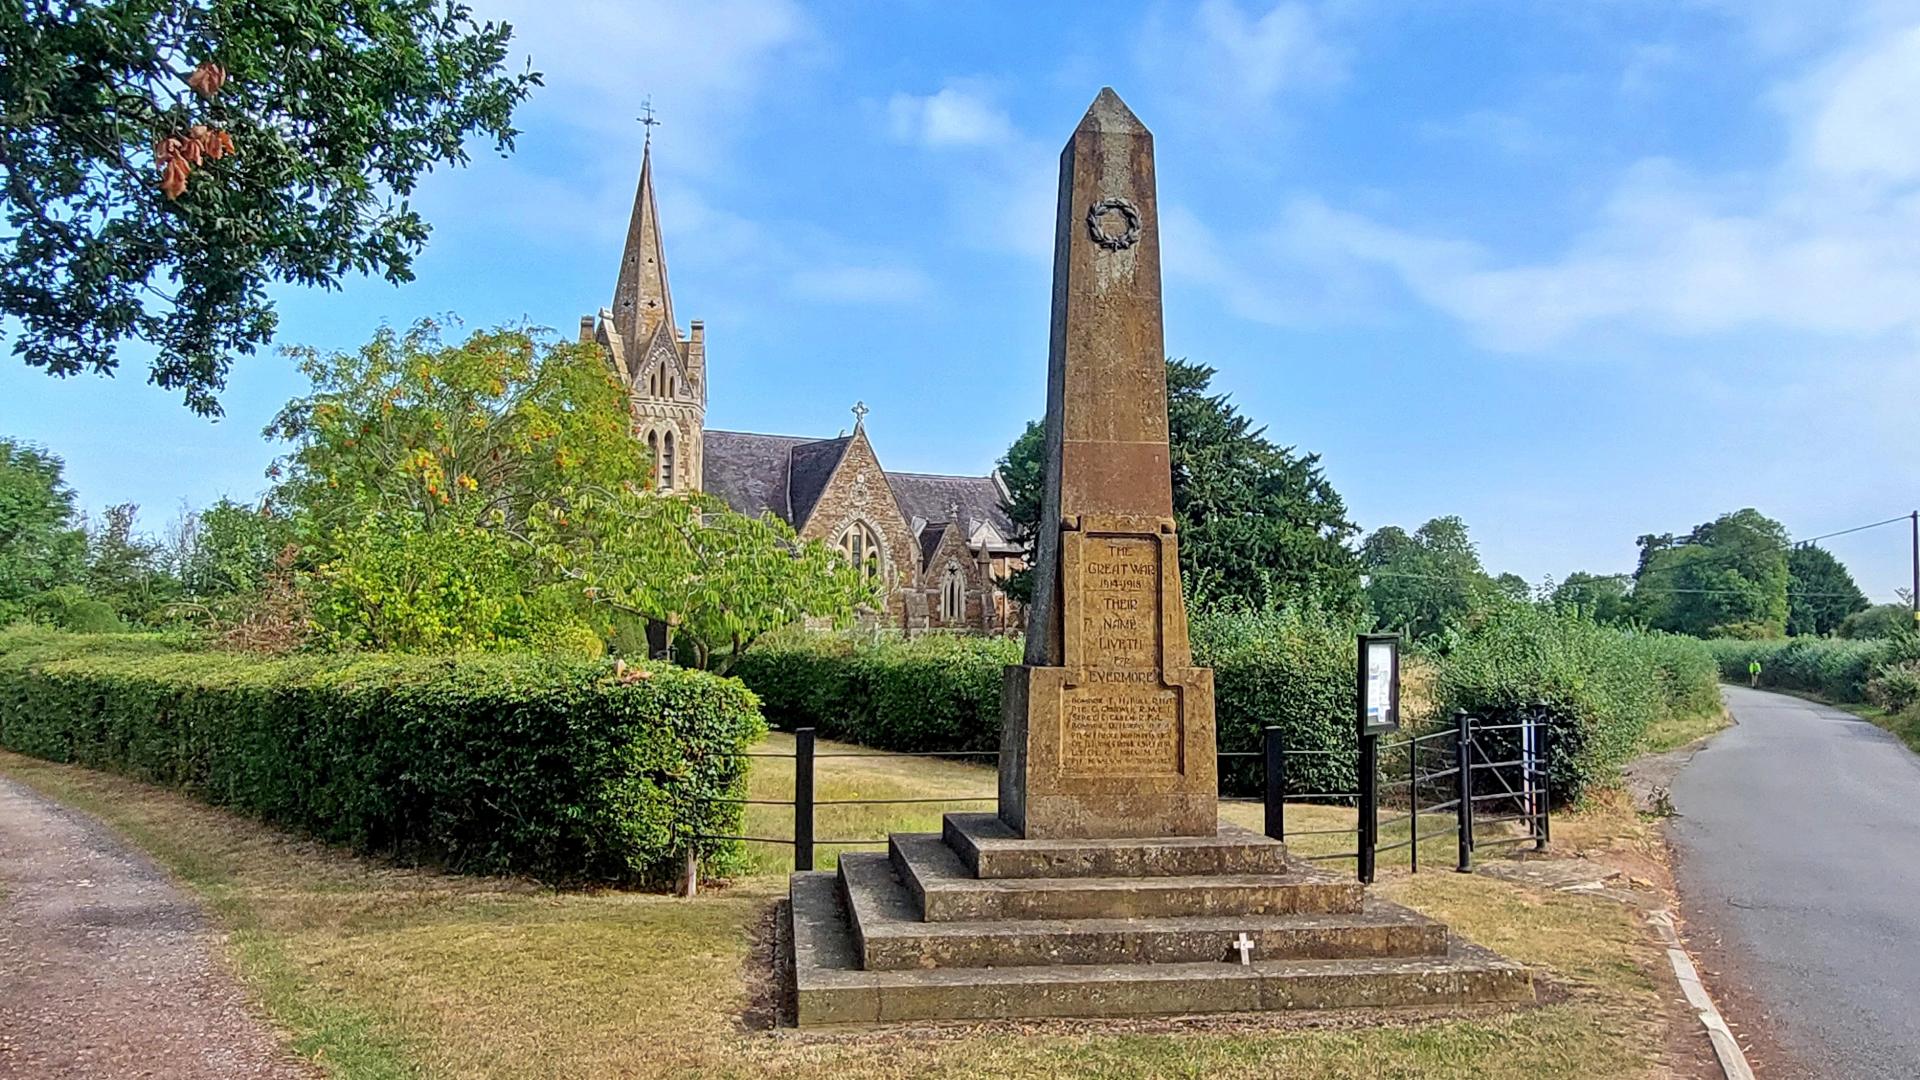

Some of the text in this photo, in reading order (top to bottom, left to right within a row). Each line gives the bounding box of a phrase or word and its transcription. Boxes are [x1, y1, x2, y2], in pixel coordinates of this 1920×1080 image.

[1108, 545, 1133, 557] THE
[1088, 562, 1155, 575] GREAT WAR
[1104, 597, 1138, 610] THEIR
[1103, 617, 1137, 631] NAME
[1099, 638, 1143, 650] LIVETH
[1089, 671, 1153, 683] EVERMORE
